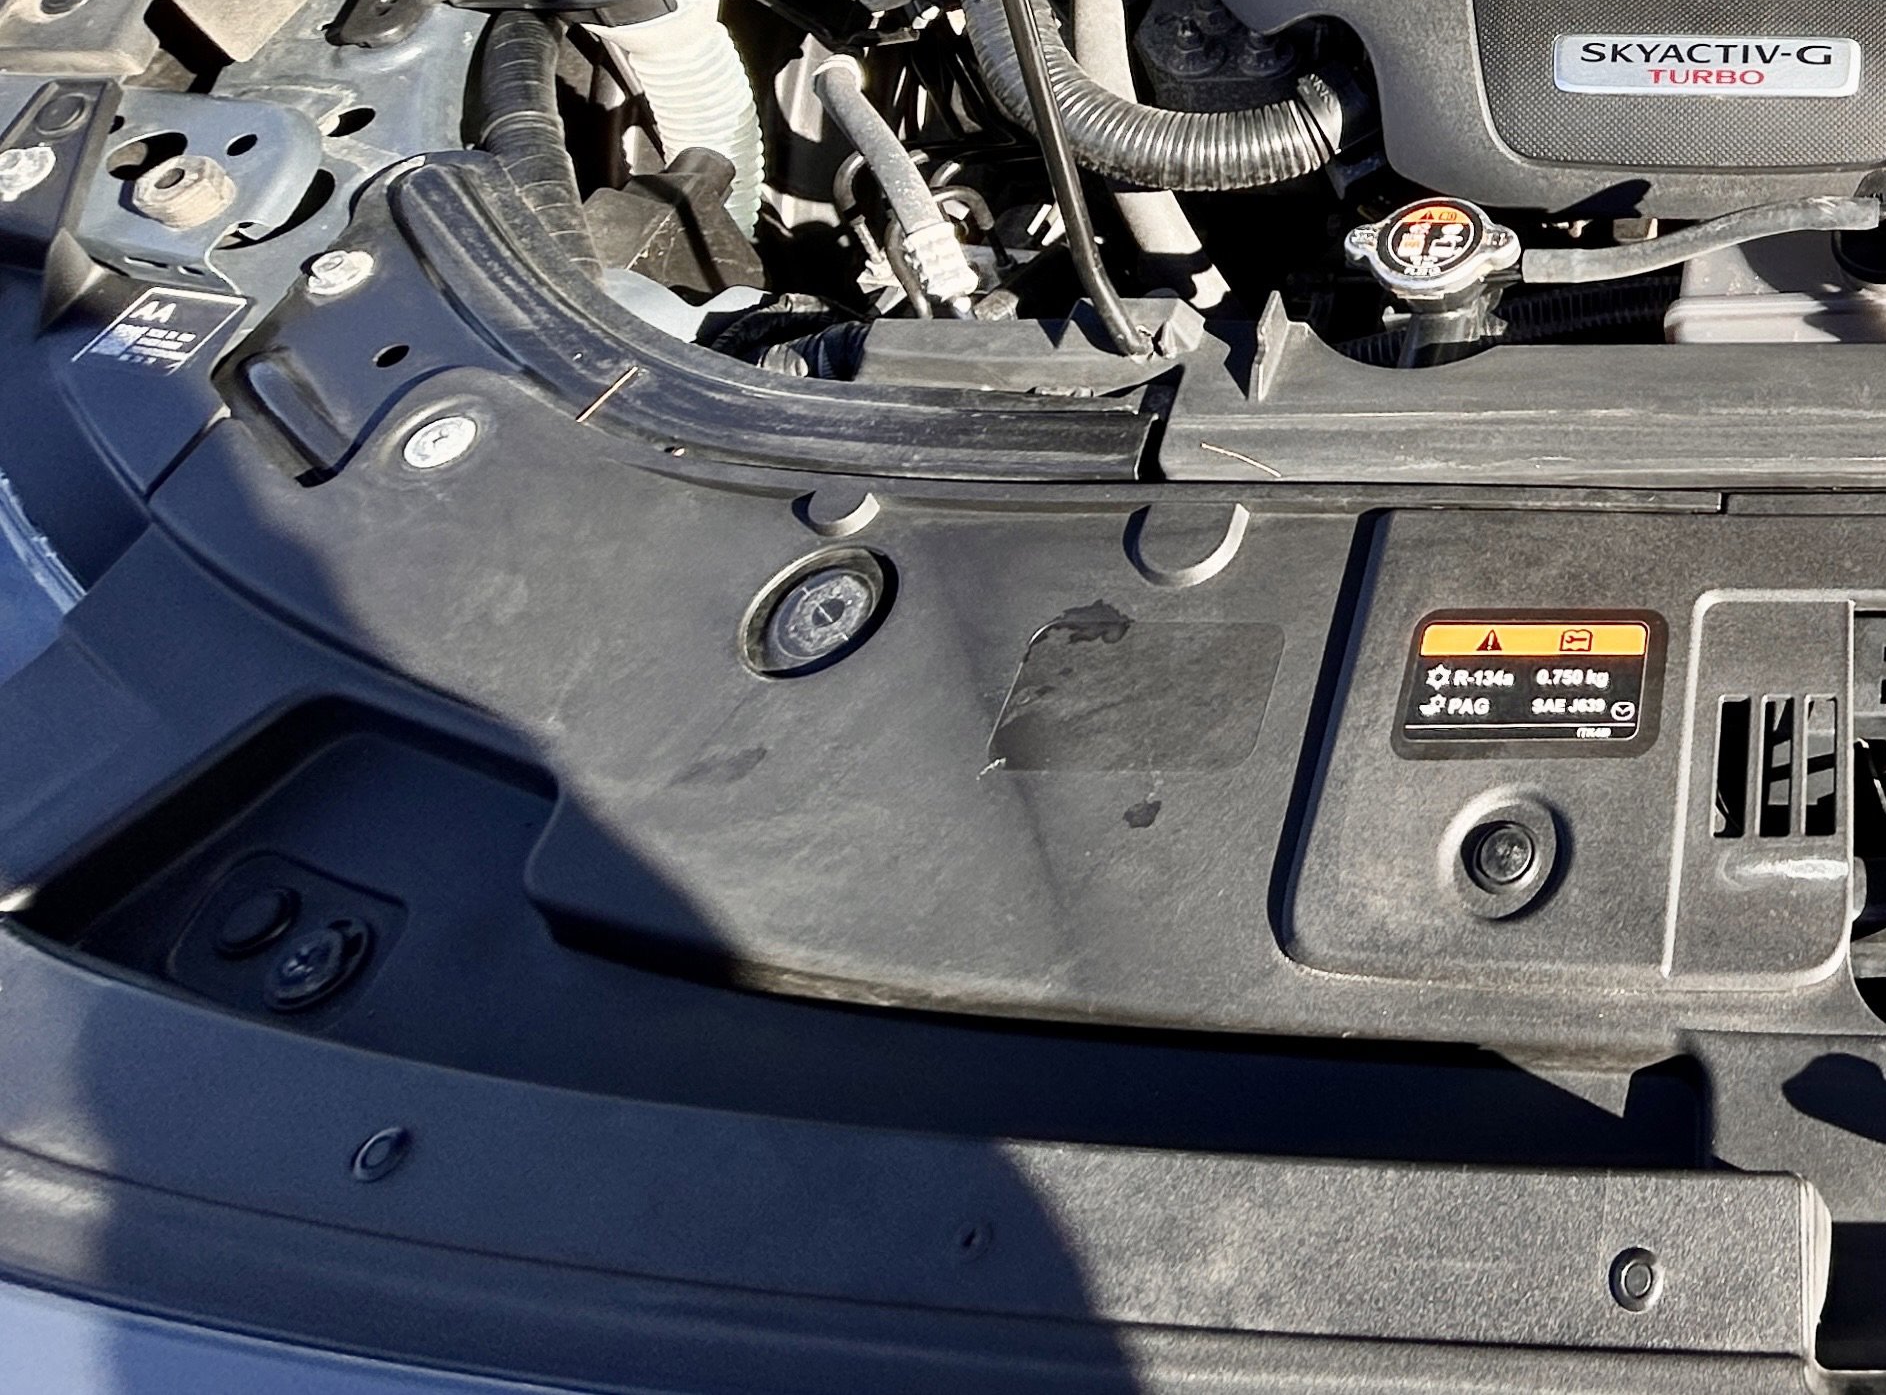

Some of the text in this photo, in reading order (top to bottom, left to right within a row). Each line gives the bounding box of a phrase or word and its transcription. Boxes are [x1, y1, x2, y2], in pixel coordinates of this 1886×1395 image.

[1580, 42, 1832, 65] SKYACTIV-G
[1648, 69, 1764, 85] TURBO
[1453, 669, 1515, 687] R-134a
[1585, 669, 1610, 689] kg
[1447, 698, 1490, 715] PAG
[1531, 698, 1567, 715] SAE
